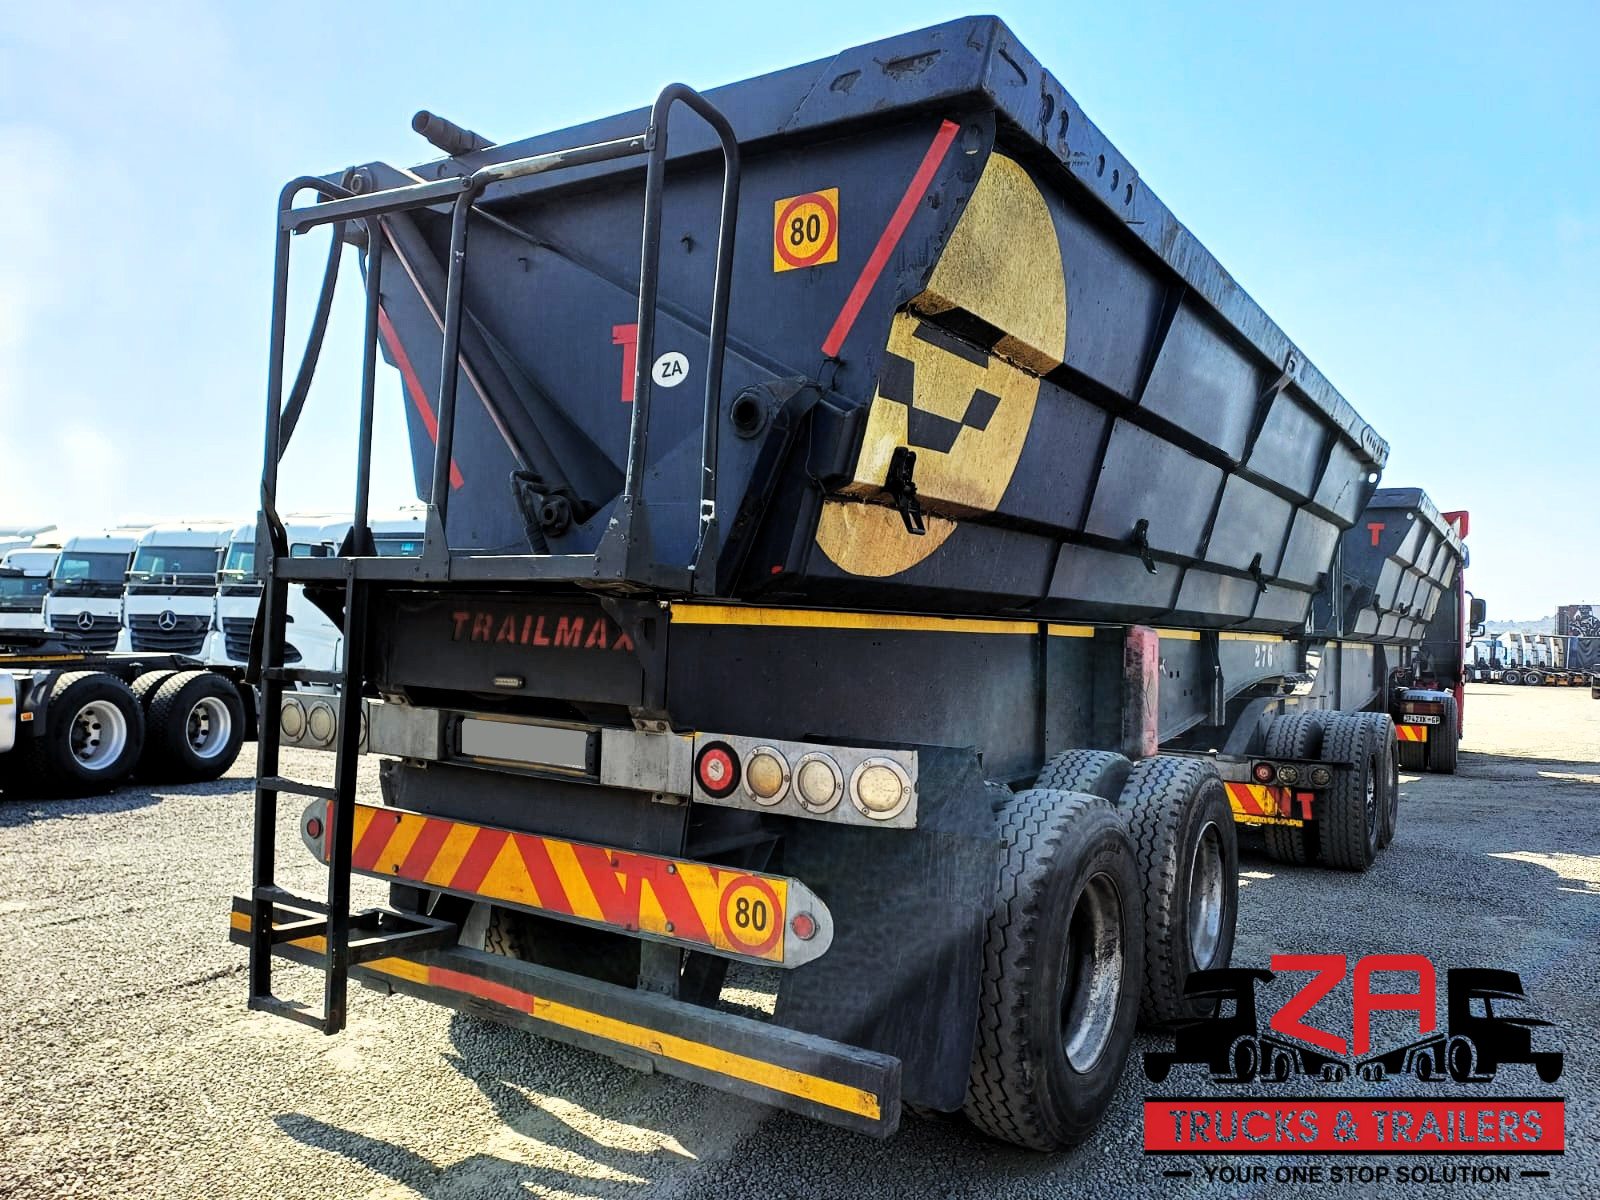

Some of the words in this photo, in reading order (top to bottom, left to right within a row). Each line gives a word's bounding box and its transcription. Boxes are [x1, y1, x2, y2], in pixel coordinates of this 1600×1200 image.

[790, 214, 820, 245] 80
[662, 360, 682, 378] ZA
[735, 897, 767, 931] 80
